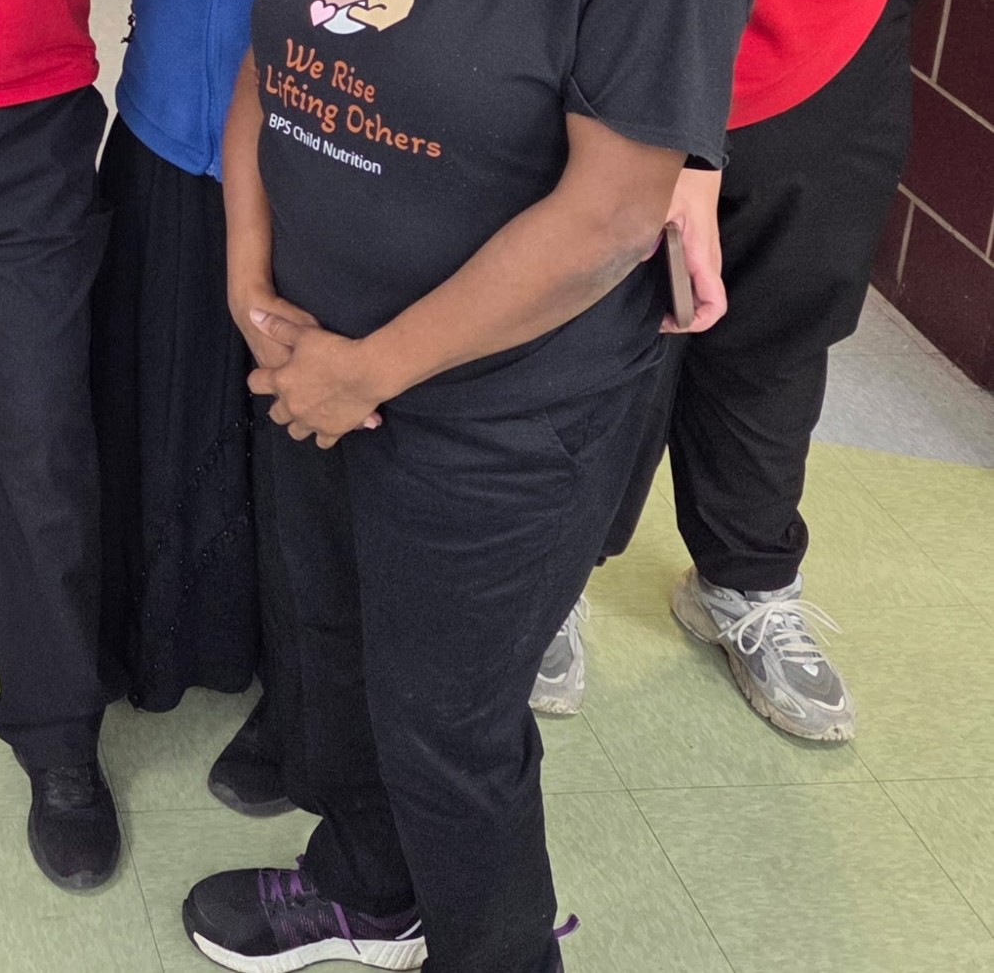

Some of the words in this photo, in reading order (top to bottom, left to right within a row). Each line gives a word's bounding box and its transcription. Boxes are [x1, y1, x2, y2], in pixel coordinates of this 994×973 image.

[286, 38, 324, 79] We
[331, 60, 375, 103] Rise
[265, 65, 339, 133] Lifting
[346, 105, 442, 158] Others
[269, 113, 292, 135] BPS
[293, 126, 321, 152] Child
[323, 140, 381, 175] Nutrition
